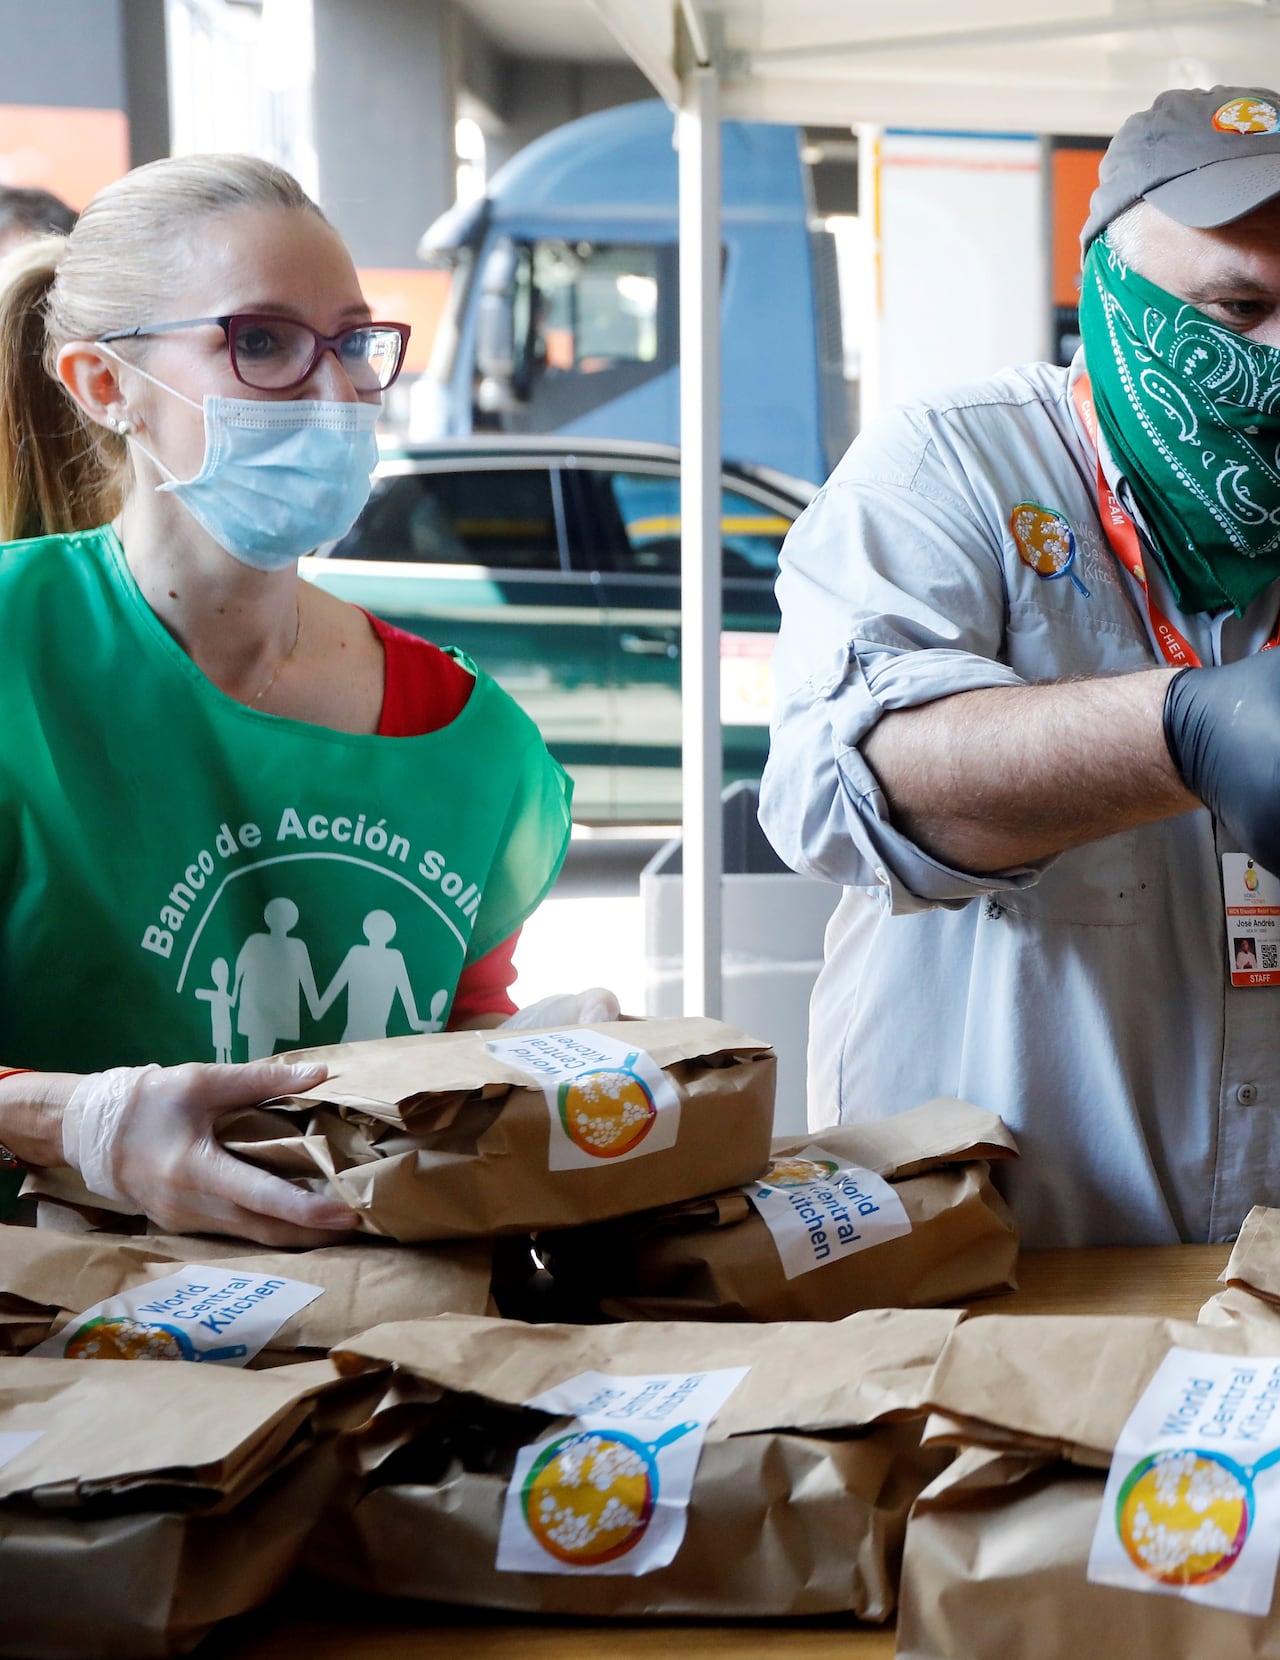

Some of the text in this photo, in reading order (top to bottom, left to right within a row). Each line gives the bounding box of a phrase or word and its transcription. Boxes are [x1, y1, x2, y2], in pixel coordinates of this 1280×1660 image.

[1158, 625, 1186, 660] CHEF
[141, 807, 482, 959] Banco de Acción Soli
[1236, 919, 1275, 927] José Andrés
[1249, 974, 1271, 983] STAFF
[507, 1048, 562, 1074] World
[520, 1038, 586, 1069] Central
[549, 1033, 613, 1063] Kitchen
[138, 1284, 209, 1315] World
[173, 1277, 254, 1320] Central
[200, 1278, 287, 1334] Kitchen
[1159, 1376, 1215, 1436] World
[1199, 1366, 1258, 1437] Central
